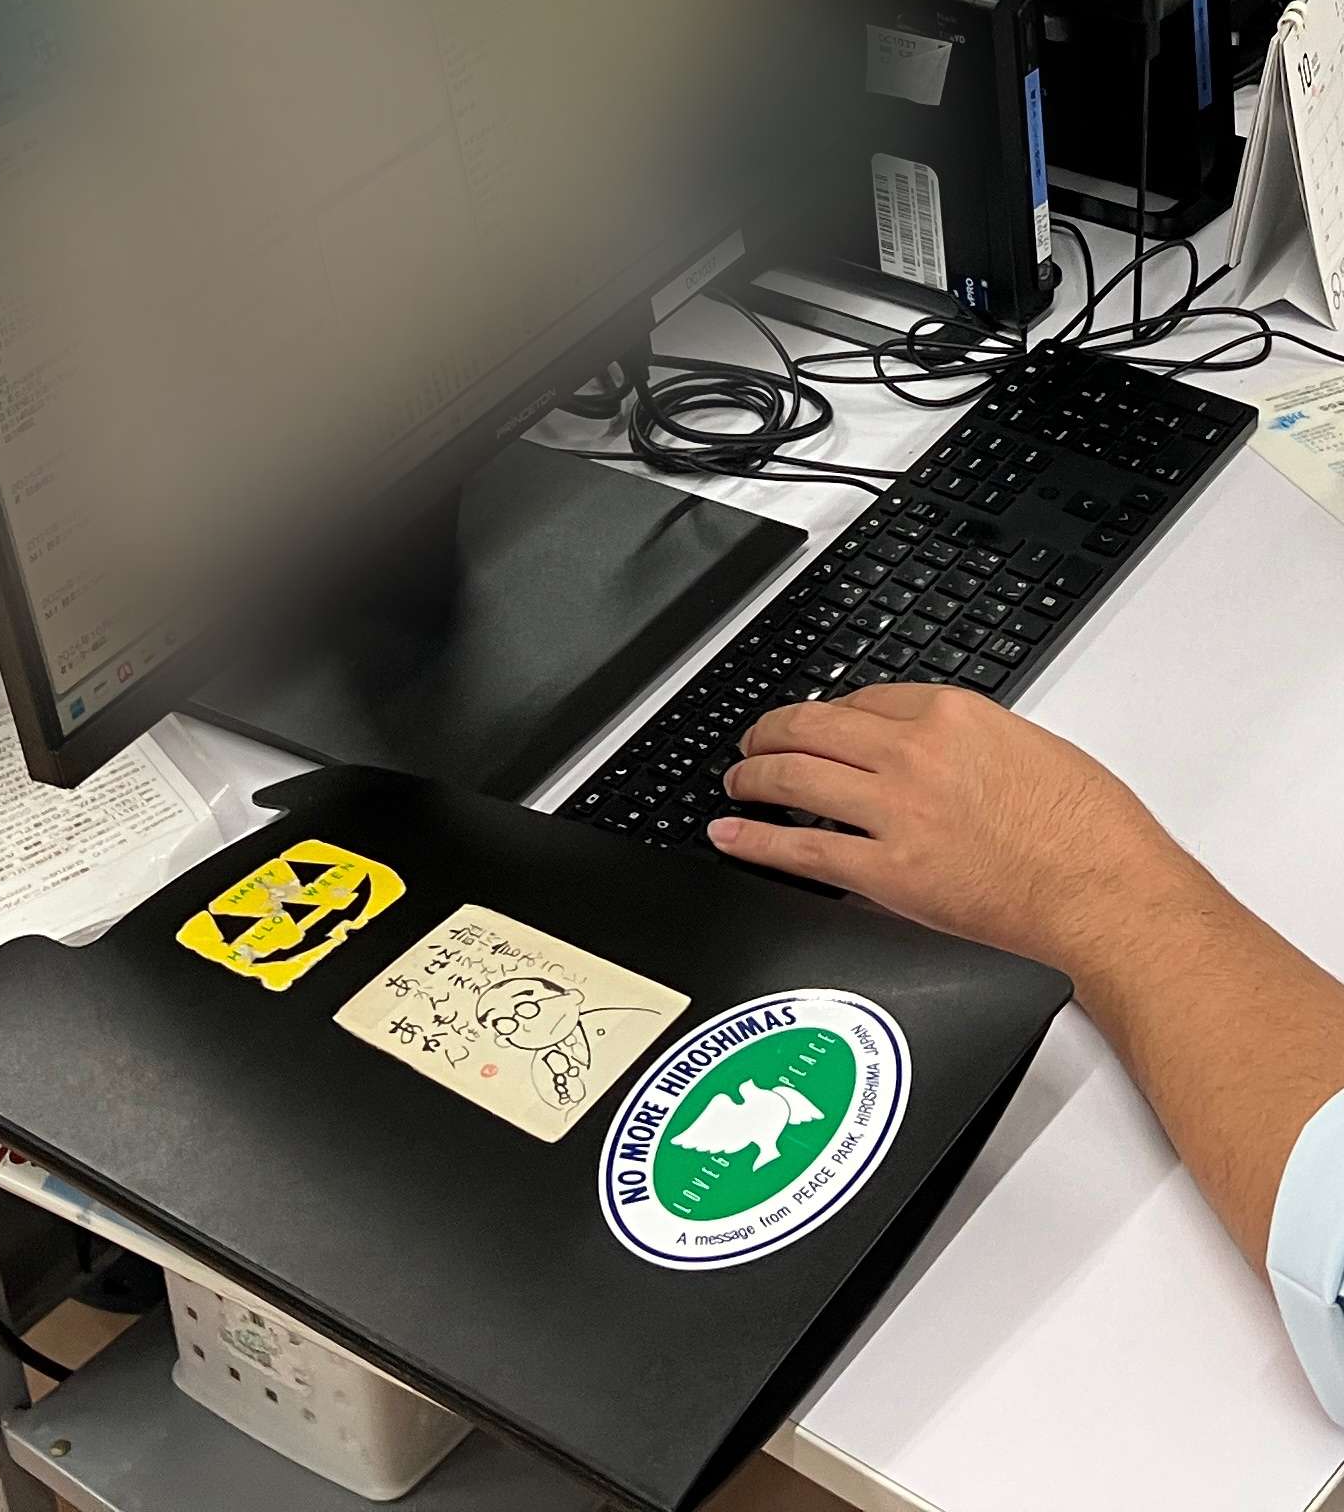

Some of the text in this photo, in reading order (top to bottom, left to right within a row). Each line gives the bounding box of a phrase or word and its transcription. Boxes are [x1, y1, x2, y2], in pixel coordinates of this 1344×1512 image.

[1297, 52, 1313, 97] 10
[227, 914, 284, 962] HLLO
[617, 1005, 798, 1206] NO MORE HIROSHIMAS
[676, 1022, 882, 1247] A message from PEACE PARK, HIROSHIMA JAPAN
